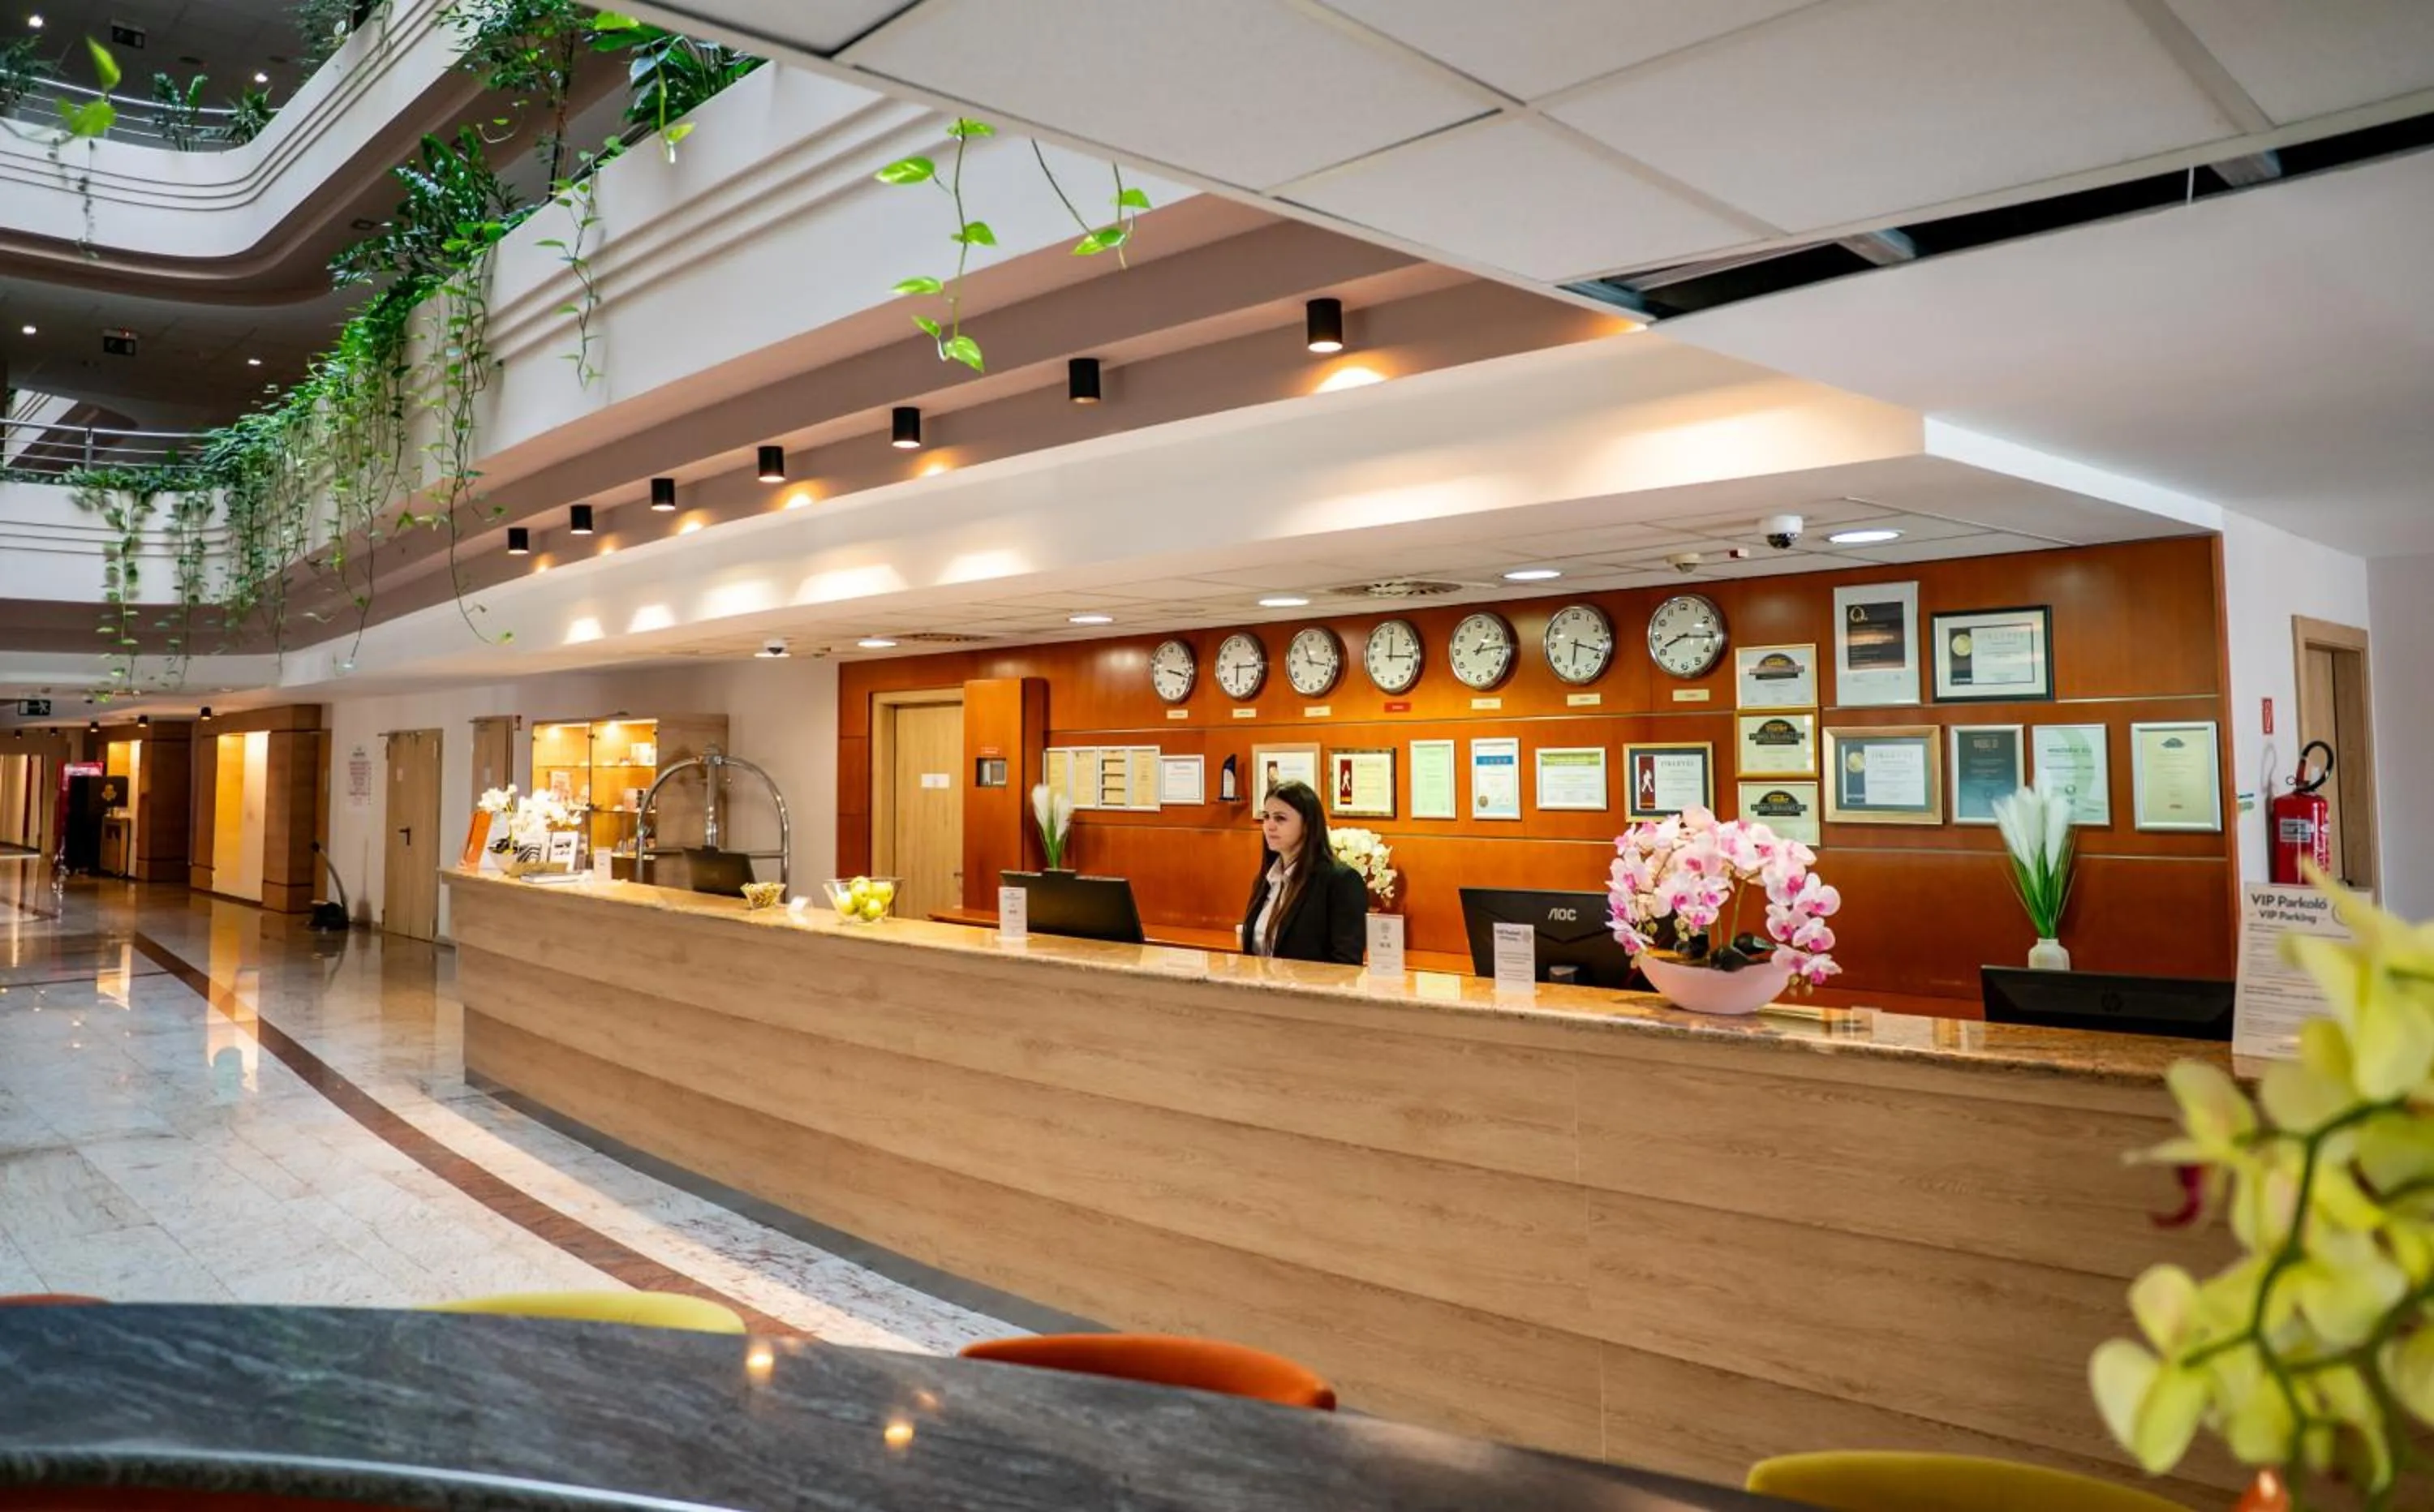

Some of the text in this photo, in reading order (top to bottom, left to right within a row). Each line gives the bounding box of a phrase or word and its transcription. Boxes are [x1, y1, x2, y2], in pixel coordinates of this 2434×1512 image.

[2251, 893, 2328, 909] VIP Parkoló
[1547, 908, 1576, 921] AOC
[2259, 909, 2316, 925] VIP Parking
